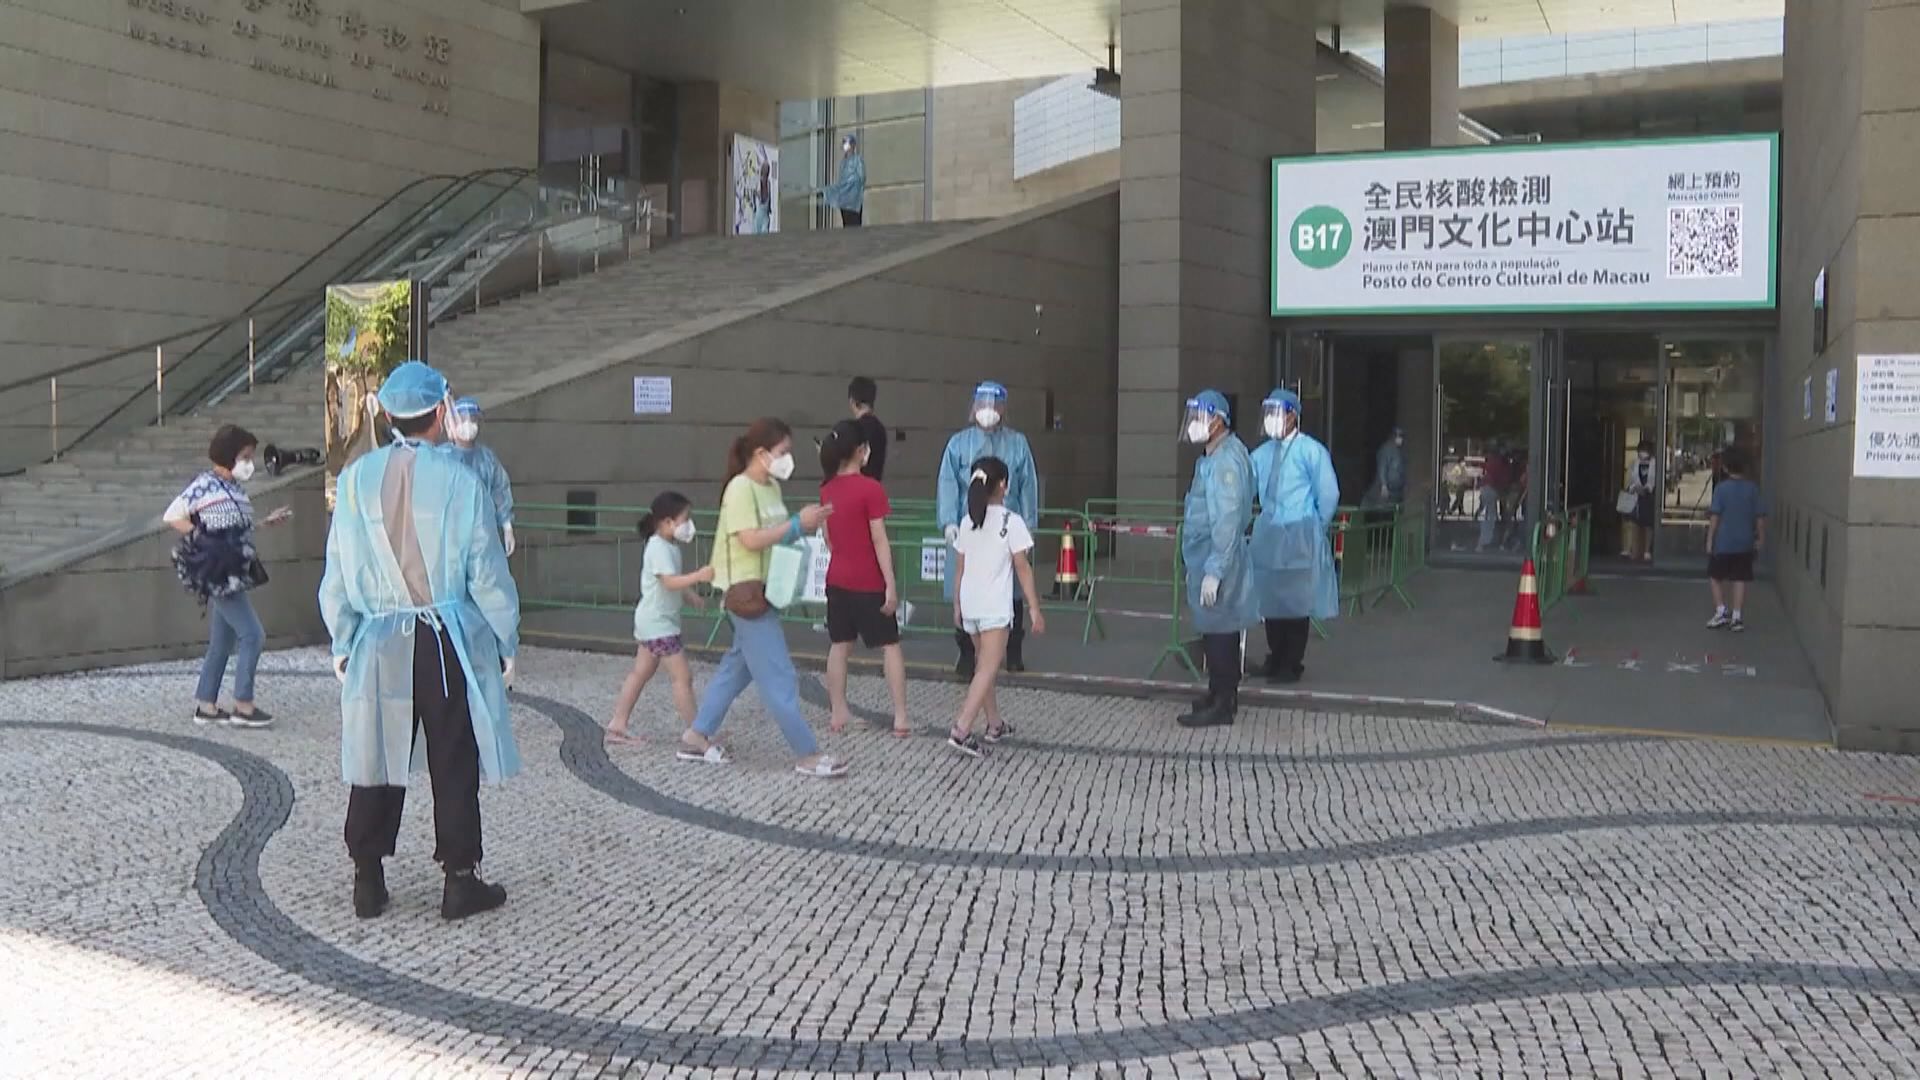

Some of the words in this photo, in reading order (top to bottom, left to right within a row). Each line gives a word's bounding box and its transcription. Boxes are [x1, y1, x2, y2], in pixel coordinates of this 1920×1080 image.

[1668, 171, 1740, 190] 網上預約
[1364, 174, 1551, 211] 全民核酸檢測
[1711, 190, 1740, 200] Online
[1298, 224, 1343, 251] B17
[1363, 208, 1634, 251] 澳門文化中心站
[1363, 262, 1393, 273] Plano
[1396, 260, 1409, 271] de
[1412, 260, 1433, 272] TAN
[1436, 261, 1460, 273] para
[1463, 259, 1488, 271] toda
[1491, 261, 1498, 270] a
[1501, 257, 1560, 272] população
[1363, 275, 1407, 289] Posto
[1411, 273, 1432, 288] do
[1437, 272, 1491, 287] Centro
[1496, 270, 1562, 287] Cultural
[1567, 269, 1589, 285] de
[1593, 268, 1650, 285] Macau
[1866, 450, 1902, 463] Priority
